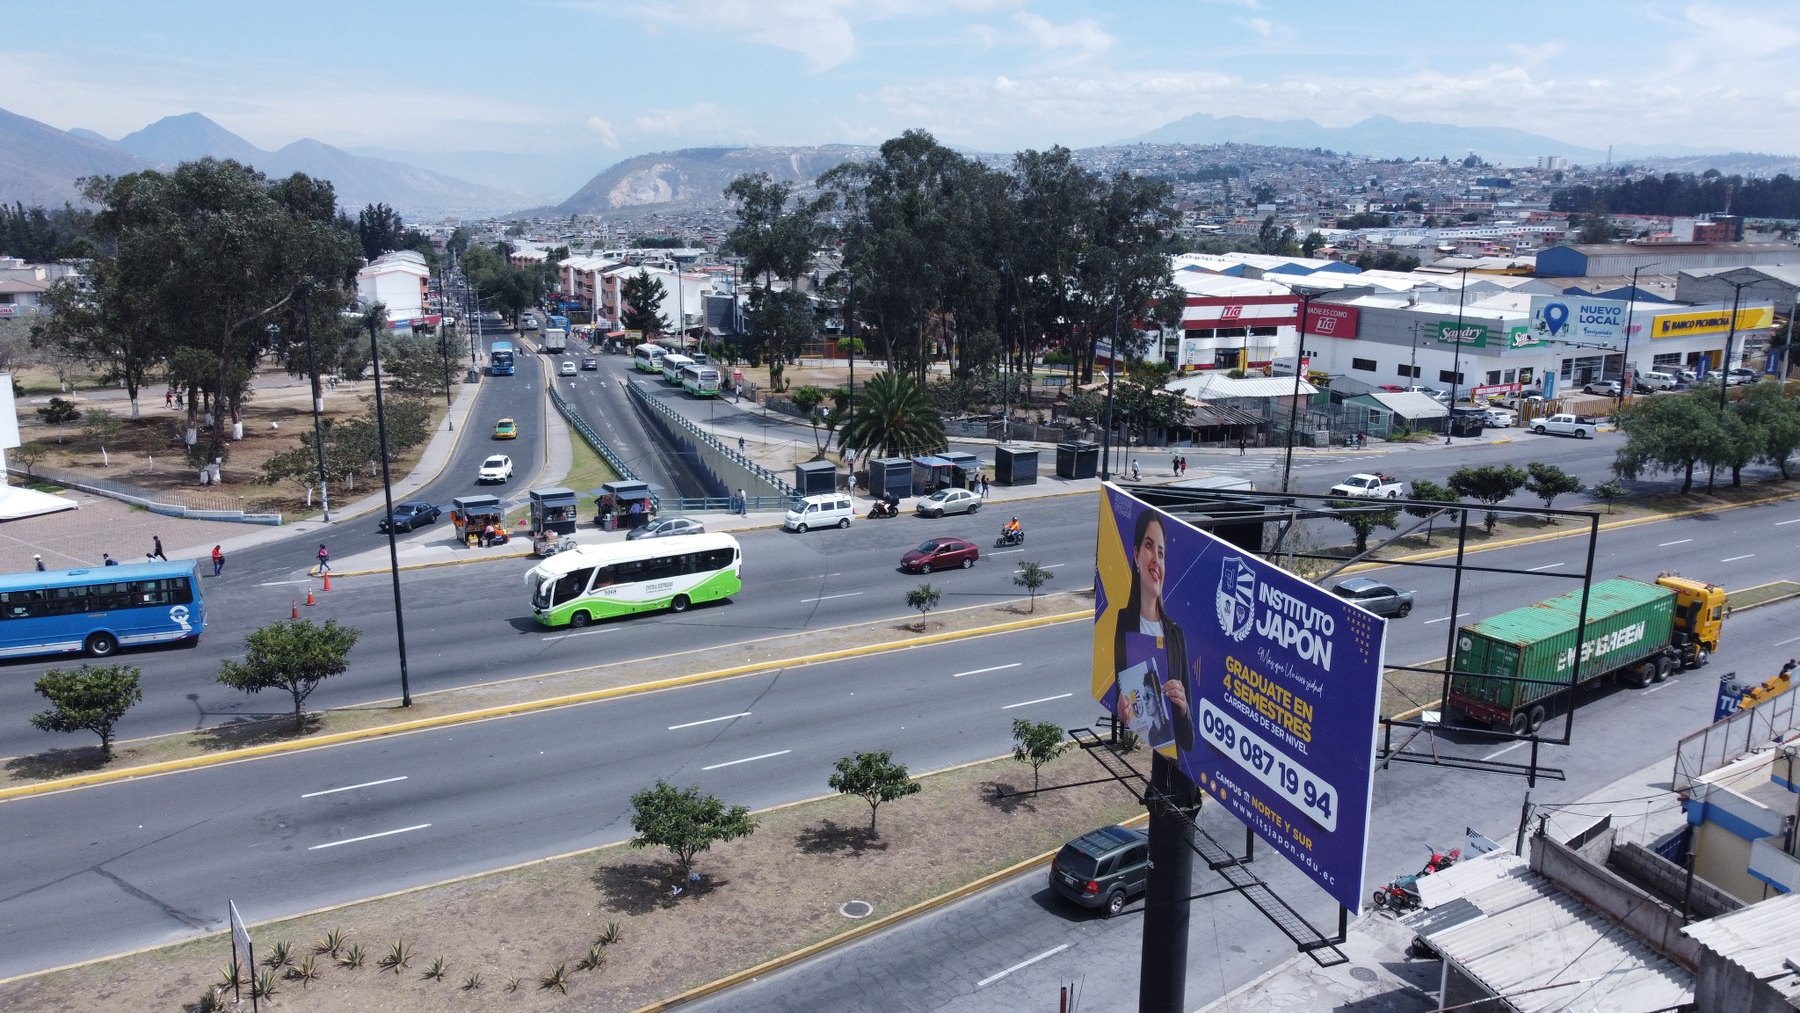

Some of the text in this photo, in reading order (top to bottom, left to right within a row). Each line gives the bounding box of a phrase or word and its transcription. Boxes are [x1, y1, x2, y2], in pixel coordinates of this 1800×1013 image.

[1330, 310, 1348, 318] COMO
[1440, 326, 1483, 341] Sandry
[1579, 315, 1619, 325] LOCAL
[1580, 305, 1621, 315] NUEVO
[1672, 317, 1729, 330] BANCO PICHINCHA
[1259, 581, 1335, 636] INSTITUTO
[1223, 674, 1312, 743] 4 SEMESTRES
[1225, 655, 1313, 722] GRADUATE EN
[1223, 692, 1308, 756] CARRERAS DE 3ER NIVEL
[1203, 709, 1331, 820] 099 087 19 94
[1215, 770, 1313, 851] CAMPUS NORTE Y SUR
